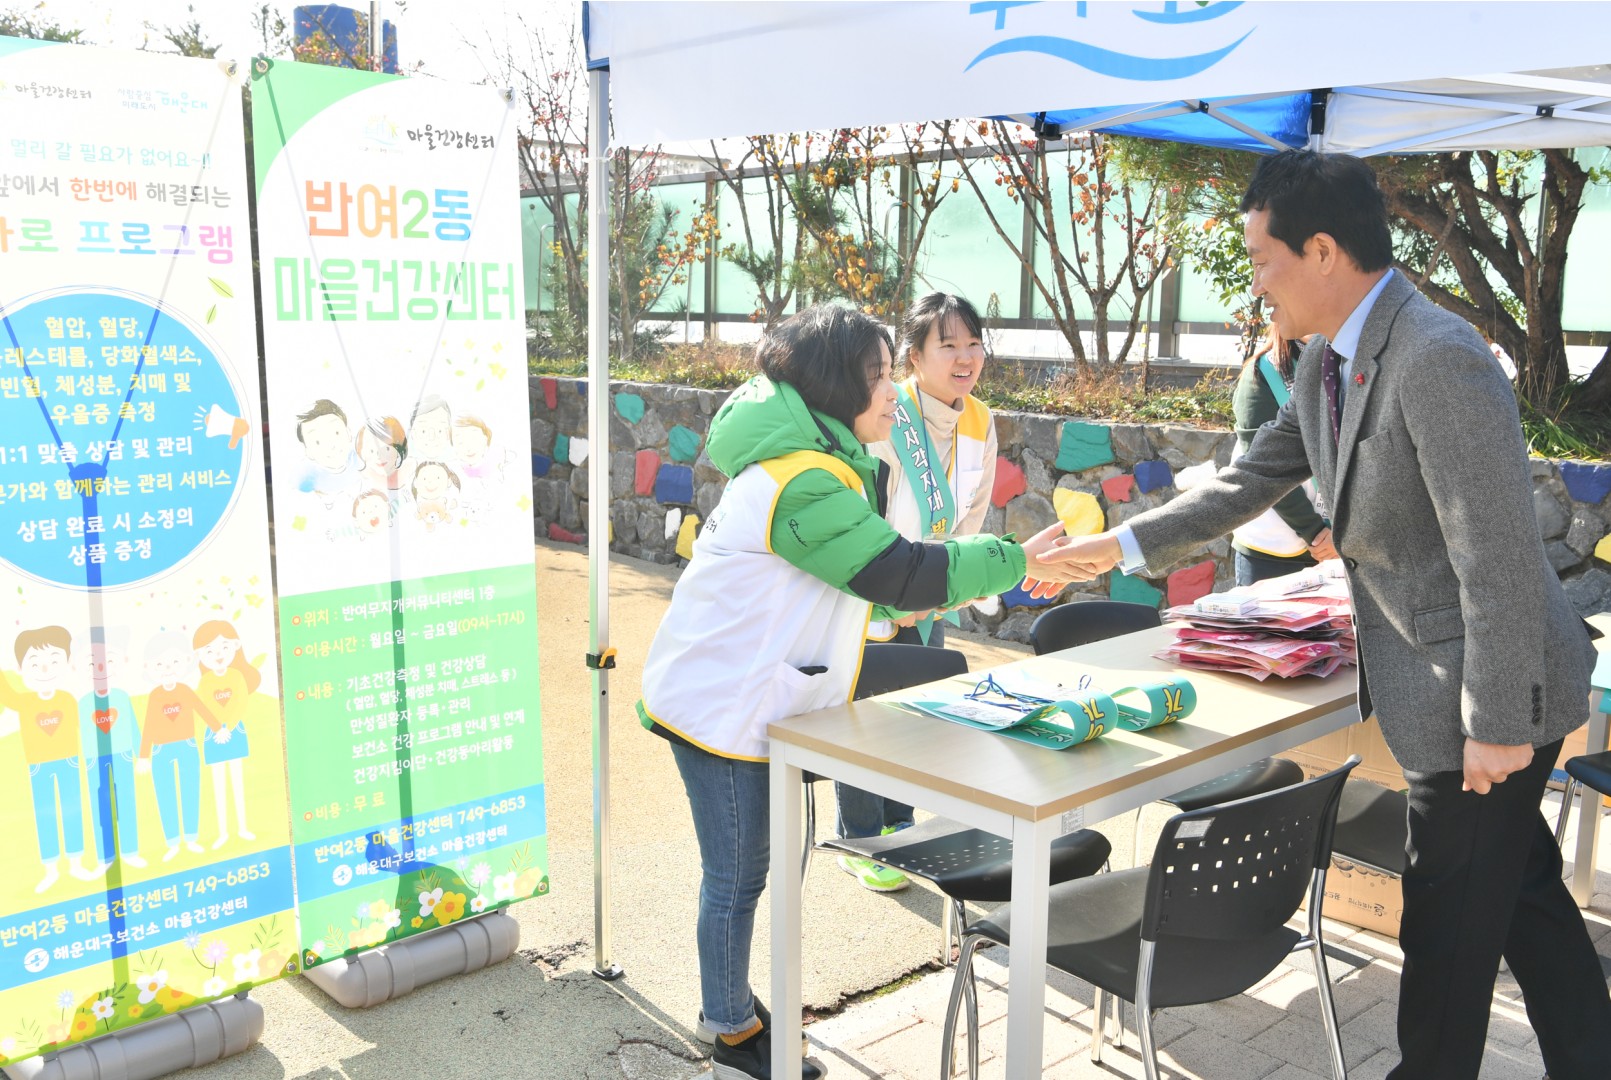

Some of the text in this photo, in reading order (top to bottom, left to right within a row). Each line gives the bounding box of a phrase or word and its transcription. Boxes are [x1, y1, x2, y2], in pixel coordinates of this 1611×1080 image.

[15, 82, 92, 100] 마을건강센터
[122, 100, 156, 111] 미래도시
[10, 138, 47, 160] 멀리
[55, 142, 73, 161] 갈
[79, 143, 133, 165] 필요가
[407, 124, 495, 151] 마을건강센터
[69, 177, 137, 203] 한번에
[146, 182, 231, 209] 해결되는
[305, 180, 472, 242] 반여2동
[76, 221, 233, 265] 프로그램
[274, 257, 516, 322] 마을건강센터
[45, 317, 144, 339] 혈압, 혈당,
[0, 345, 202, 368] 레스테롤, 당화혈색소,
[0, 372, 192, 399] 빈혈, 체성분, 치매 및
[50, 401, 156, 426] 우울증 측정
[0, 436, 193, 465] 1:1 맞춤 상담 및 관리
[54, 475, 132, 500] 함께하는
[137, 472, 173, 494] 관리
[179, 469, 233, 490] 서비스
[16, 507, 194, 543] 상담 완료 시 소정의
[67, 538, 152, 566] 상품 증정
[304, 609, 330, 628] 위치
[479, 585, 496, 601] 1층
[304, 636, 359, 658] 이용시간
[369, 629, 406, 649] 월요일
[308, 681, 334, 701] 내용
[347, 665, 420, 693] 기초건강측정
[425, 663, 436, 679] 및
[441, 653, 487, 677] 건강상담
[461, 672, 499, 689] 스트레스
[214, 690, 232, 700] LOVE
[39, 716, 60, 727] LOVE
[95, 714, 115, 726] LOVE
[163, 704, 181, 715] LOVE
[350, 709, 412, 735] 만성질환자
[352, 709, 525, 759] 보건소 건강 프로그램 안내 및 연계
[315, 801, 341, 820] 비용
[314, 795, 526, 864] 반여2동 마을건강센터 749-6853
[355, 825, 508, 877] 해운대구보건소 마을건강센터
[0, 861, 273, 947] 반여2동 마을건강센터 749-6853
[53, 896, 249, 961] 해운대구보건소 마을건강센터
